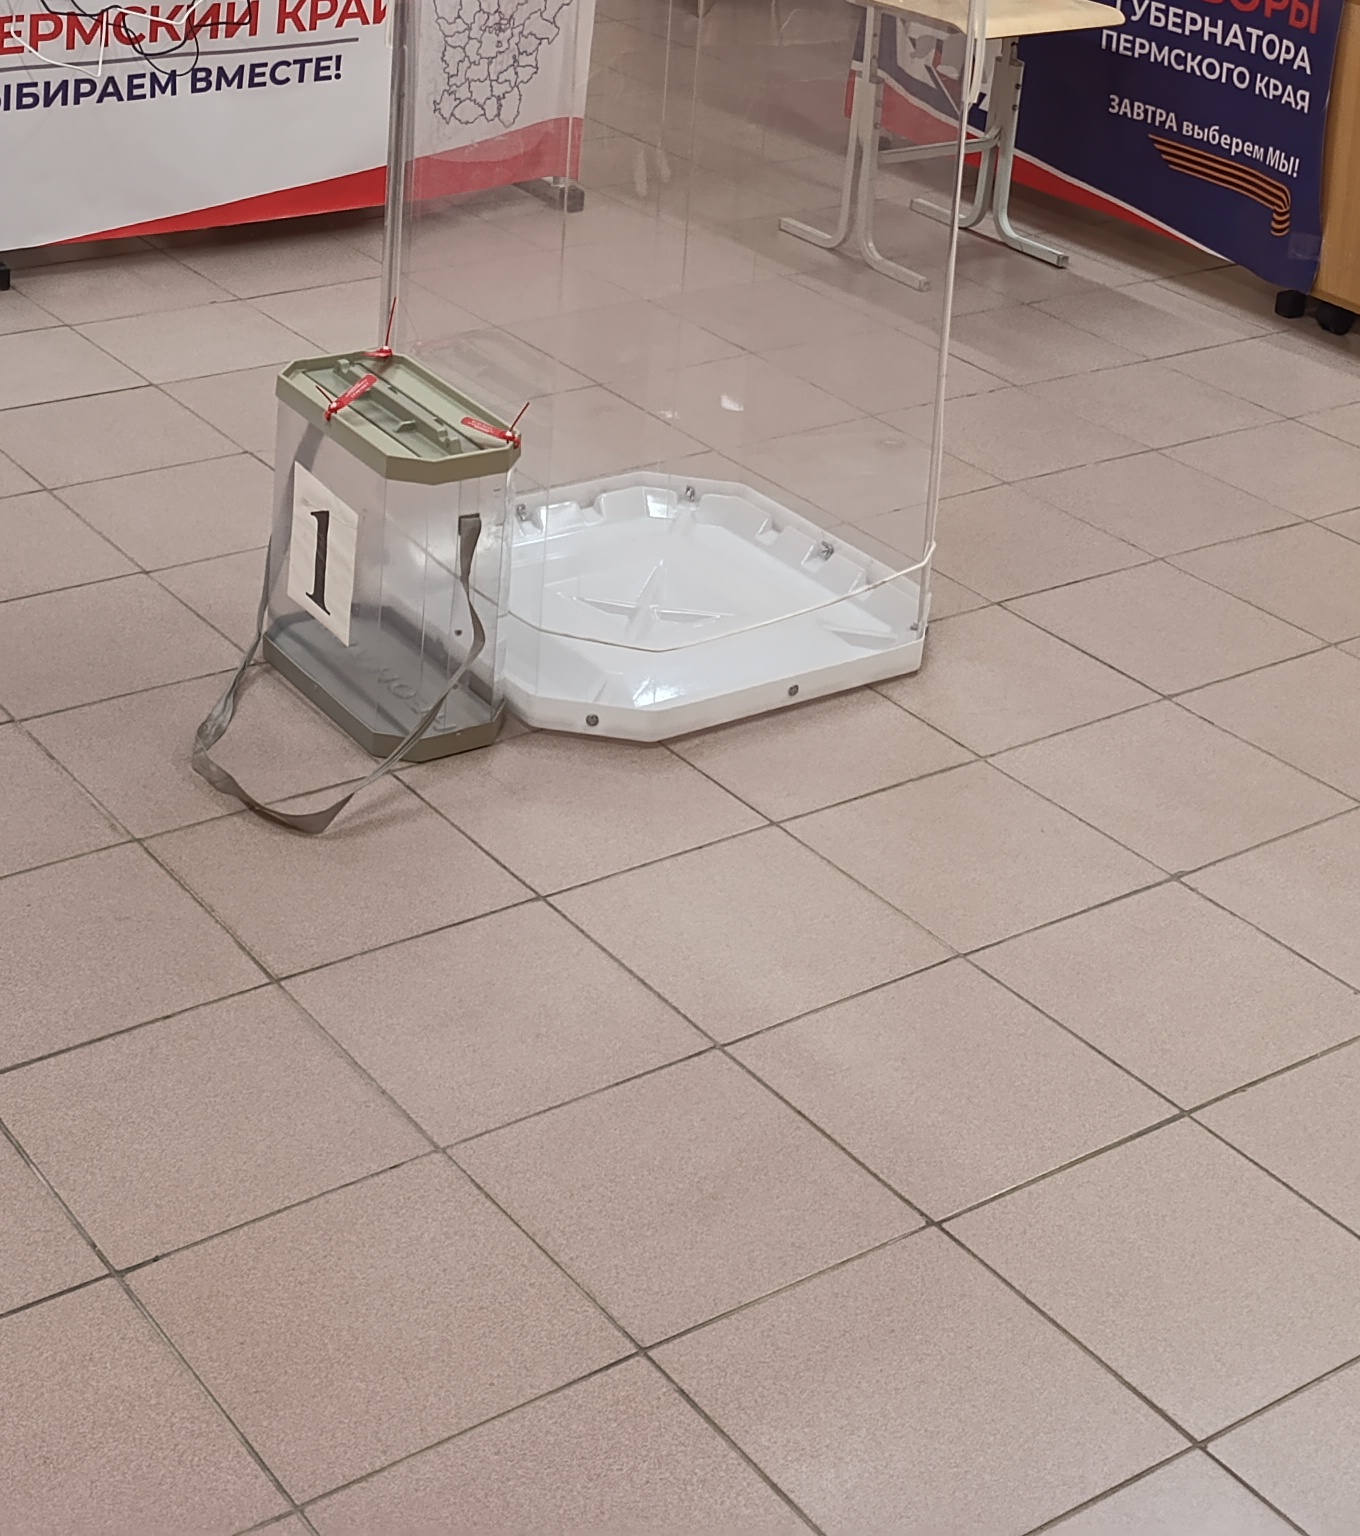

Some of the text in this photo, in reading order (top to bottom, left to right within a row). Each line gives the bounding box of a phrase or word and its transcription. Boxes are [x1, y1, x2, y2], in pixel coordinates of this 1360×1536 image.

[190, 55, 343, 94] ВМЕСТЕ!
[1101, 29, 1311, 114] ПЕРМСКОГО КРАЯ
[1108, 94, 1300, 179] ЗАВТРА выберем МЫ!
[306, 510, 331, 616] 1
